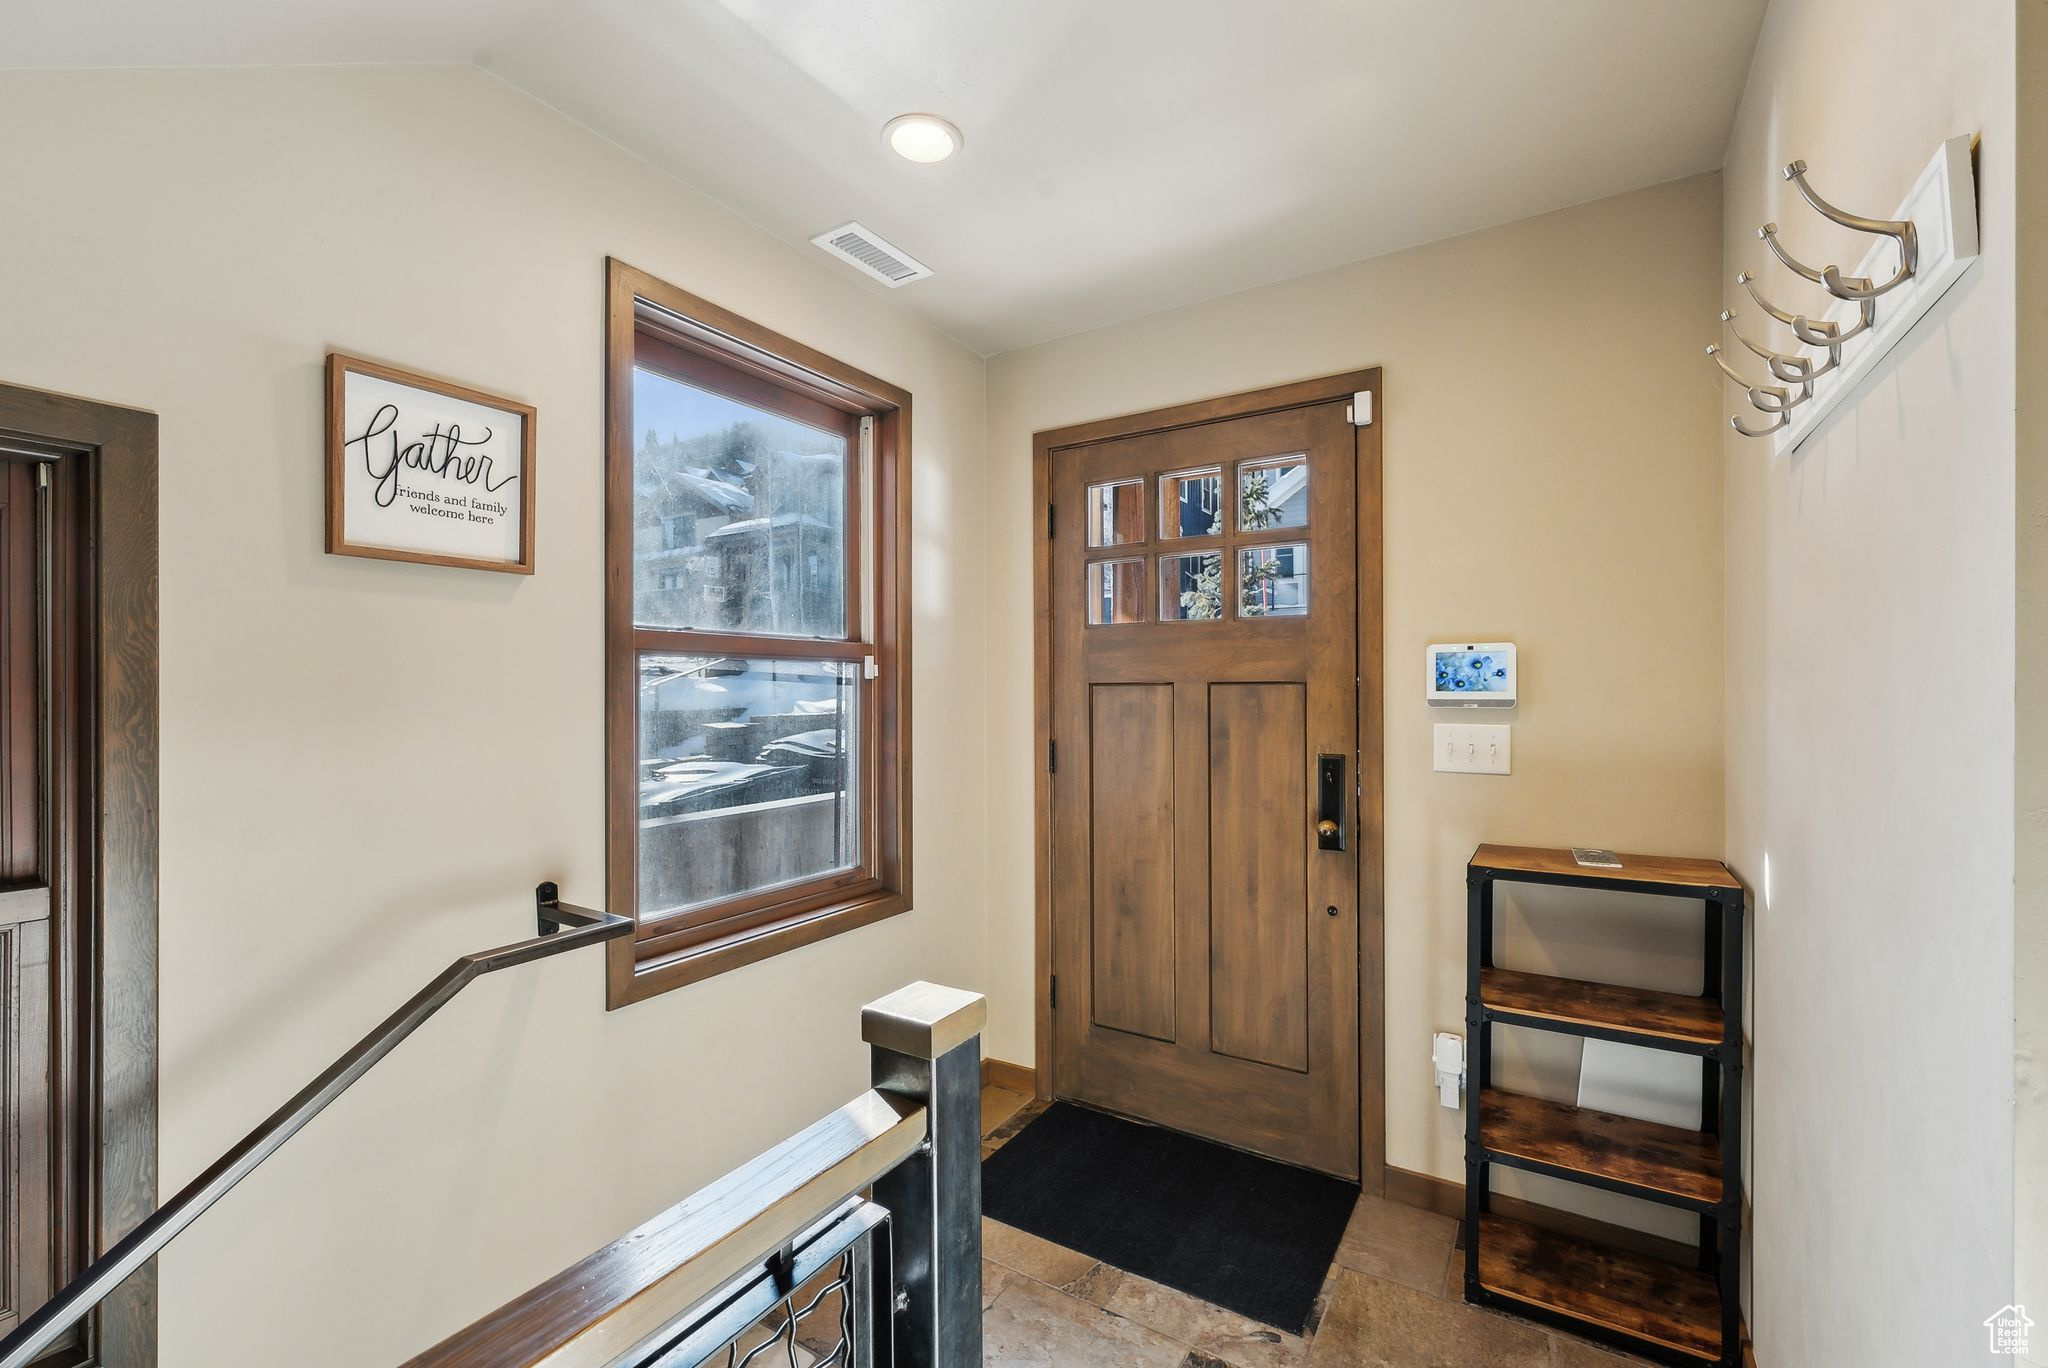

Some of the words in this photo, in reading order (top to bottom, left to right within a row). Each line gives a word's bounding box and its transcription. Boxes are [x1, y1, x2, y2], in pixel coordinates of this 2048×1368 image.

[345, 404, 517, 507] Gather
[410, 504, 465, 520] welcome
[468, 510, 494, 524] here
[444, 496, 467, 507] and
[471, 498, 508, 517] family
